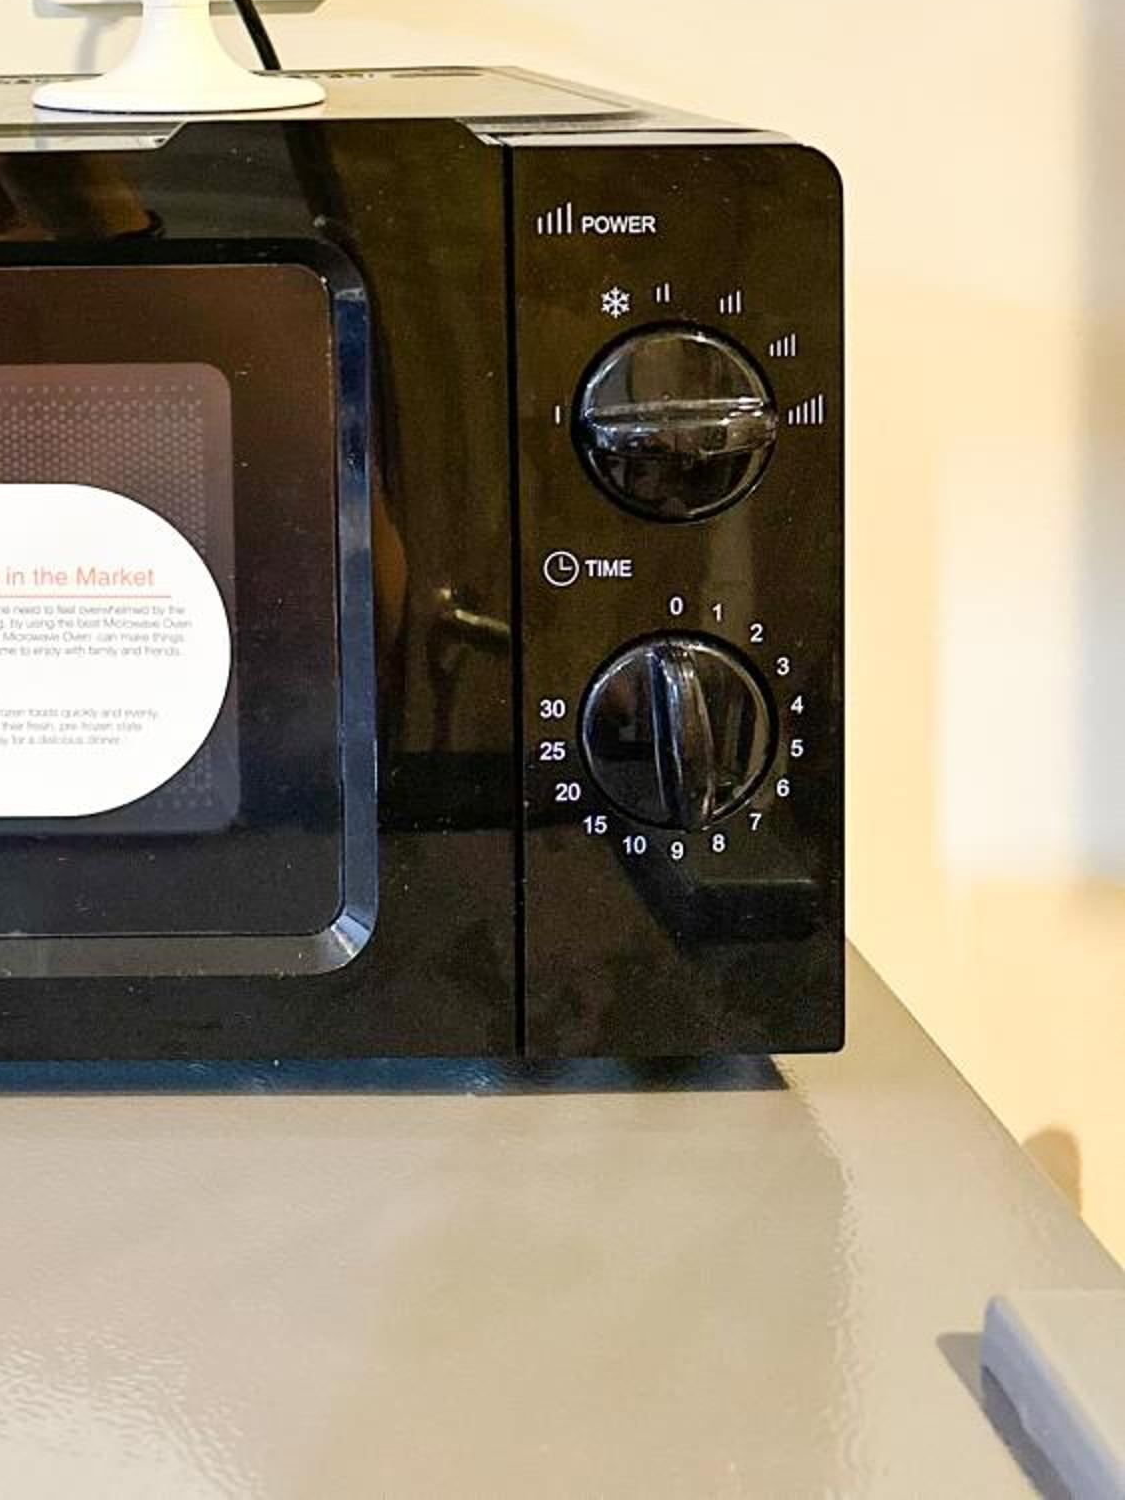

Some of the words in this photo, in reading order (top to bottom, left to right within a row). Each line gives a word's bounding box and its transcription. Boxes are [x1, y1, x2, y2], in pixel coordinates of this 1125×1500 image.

[581, 215, 656, 234] POWER
[6, 567, 25, 586] in
[33, 567, 68, 586] the
[76, 566, 155, 586] Market
[585, 559, 632, 577] TIME
[13, 605, 41, 616] need
[44, 605, 54, 616] to
[57, 605, 75, 616] feel
[153, 605, 165, 616] by
[169, 605, 185, 616] the
[670, 596, 684, 616] 0
[712, 603, 722, 622] 1
[25, 619, 55, 630] using
[58, 619, 74, 630] the
[77, 619, 100, 630] best
[104, 619, 159, 630] Microwave
[163, 619, 192, 630] Oven
[750, 623, 763, 643] 2
[2, 632, 59, 643] Microwave
[120, 632, 149, 643] make
[20, 646, 30, 657] to
[33, 646, 60, 657] enjoy
[65, 646, 88, 657] with
[89, 646, 117, 657] family
[121, 646, 141, 657] and
[776, 657, 790, 676] 3
[540, 699, 566, 719] 30
[790, 695, 804, 714] 4
[539, 741, 566, 761] 25
[790, 739, 804, 758] 5
[555, 782, 581, 802] 20
[776, 778, 790, 797] 6
[583, 815, 608, 834] 15
[749, 812, 762, 831] 7
[622, 835, 647, 855] 10
[670, 841, 684, 860] 9
[712, 833, 726, 853] 8
